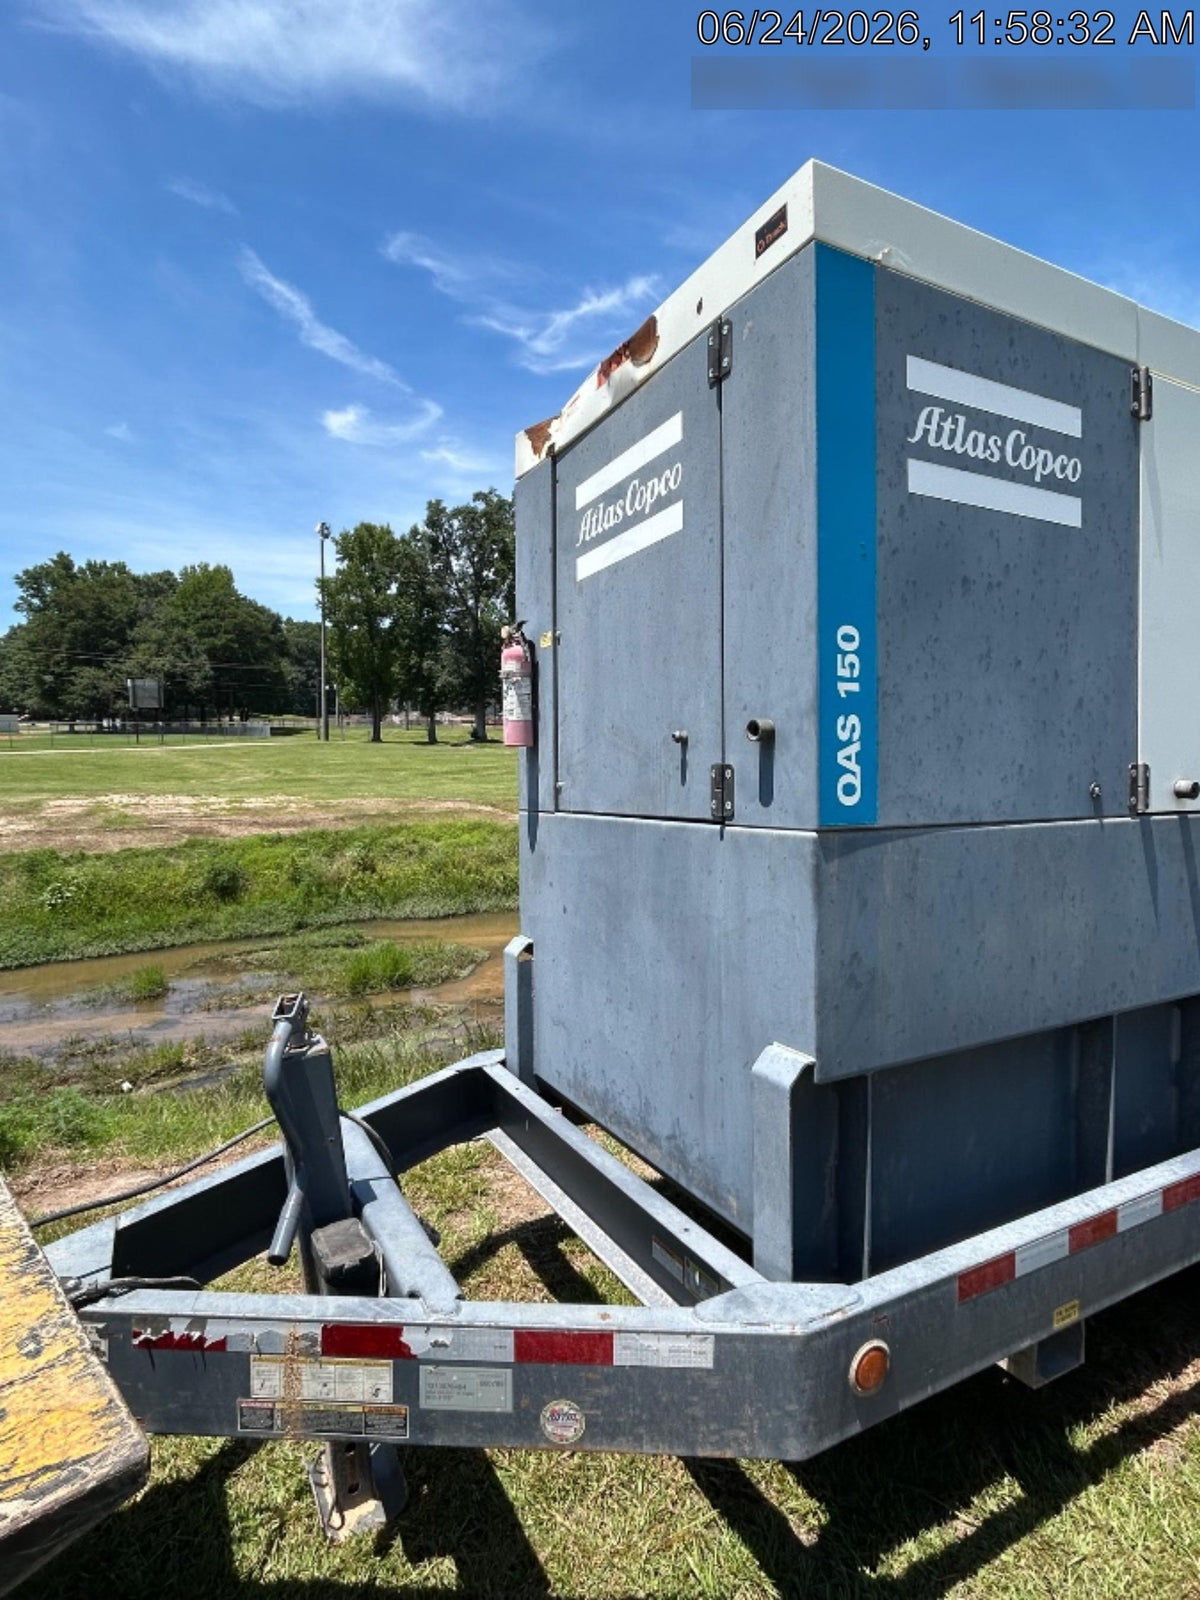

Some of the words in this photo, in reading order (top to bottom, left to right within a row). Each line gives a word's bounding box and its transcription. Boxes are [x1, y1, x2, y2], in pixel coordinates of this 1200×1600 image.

[907, 406, 1001, 463] Atlas
[1005, 429, 1082, 483] Copco
[836, 625, 860, 698] 150
[836, 714, 861, 806] QAS
